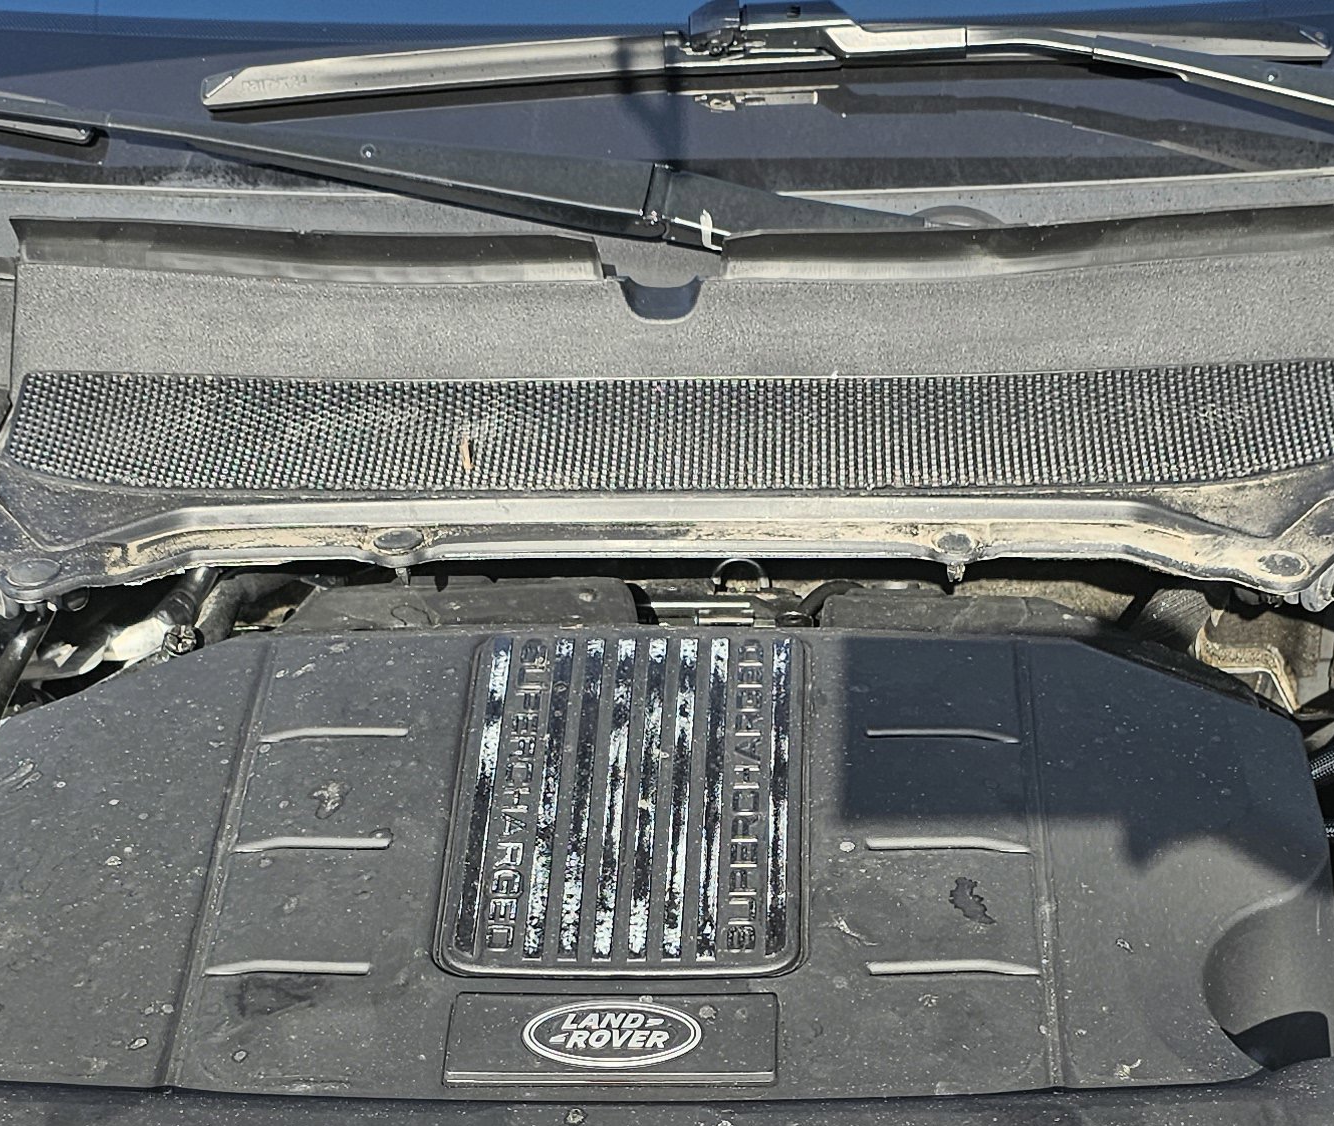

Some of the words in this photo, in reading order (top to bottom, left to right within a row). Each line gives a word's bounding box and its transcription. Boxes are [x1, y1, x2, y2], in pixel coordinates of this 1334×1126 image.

[486, 639, 550, 953] SUPERCHARGED
[726, 638, 765, 954] SUPERCHARGED
[561, 1012, 641, 1030] LAND
[566, 1029, 670, 1049] ROVER
